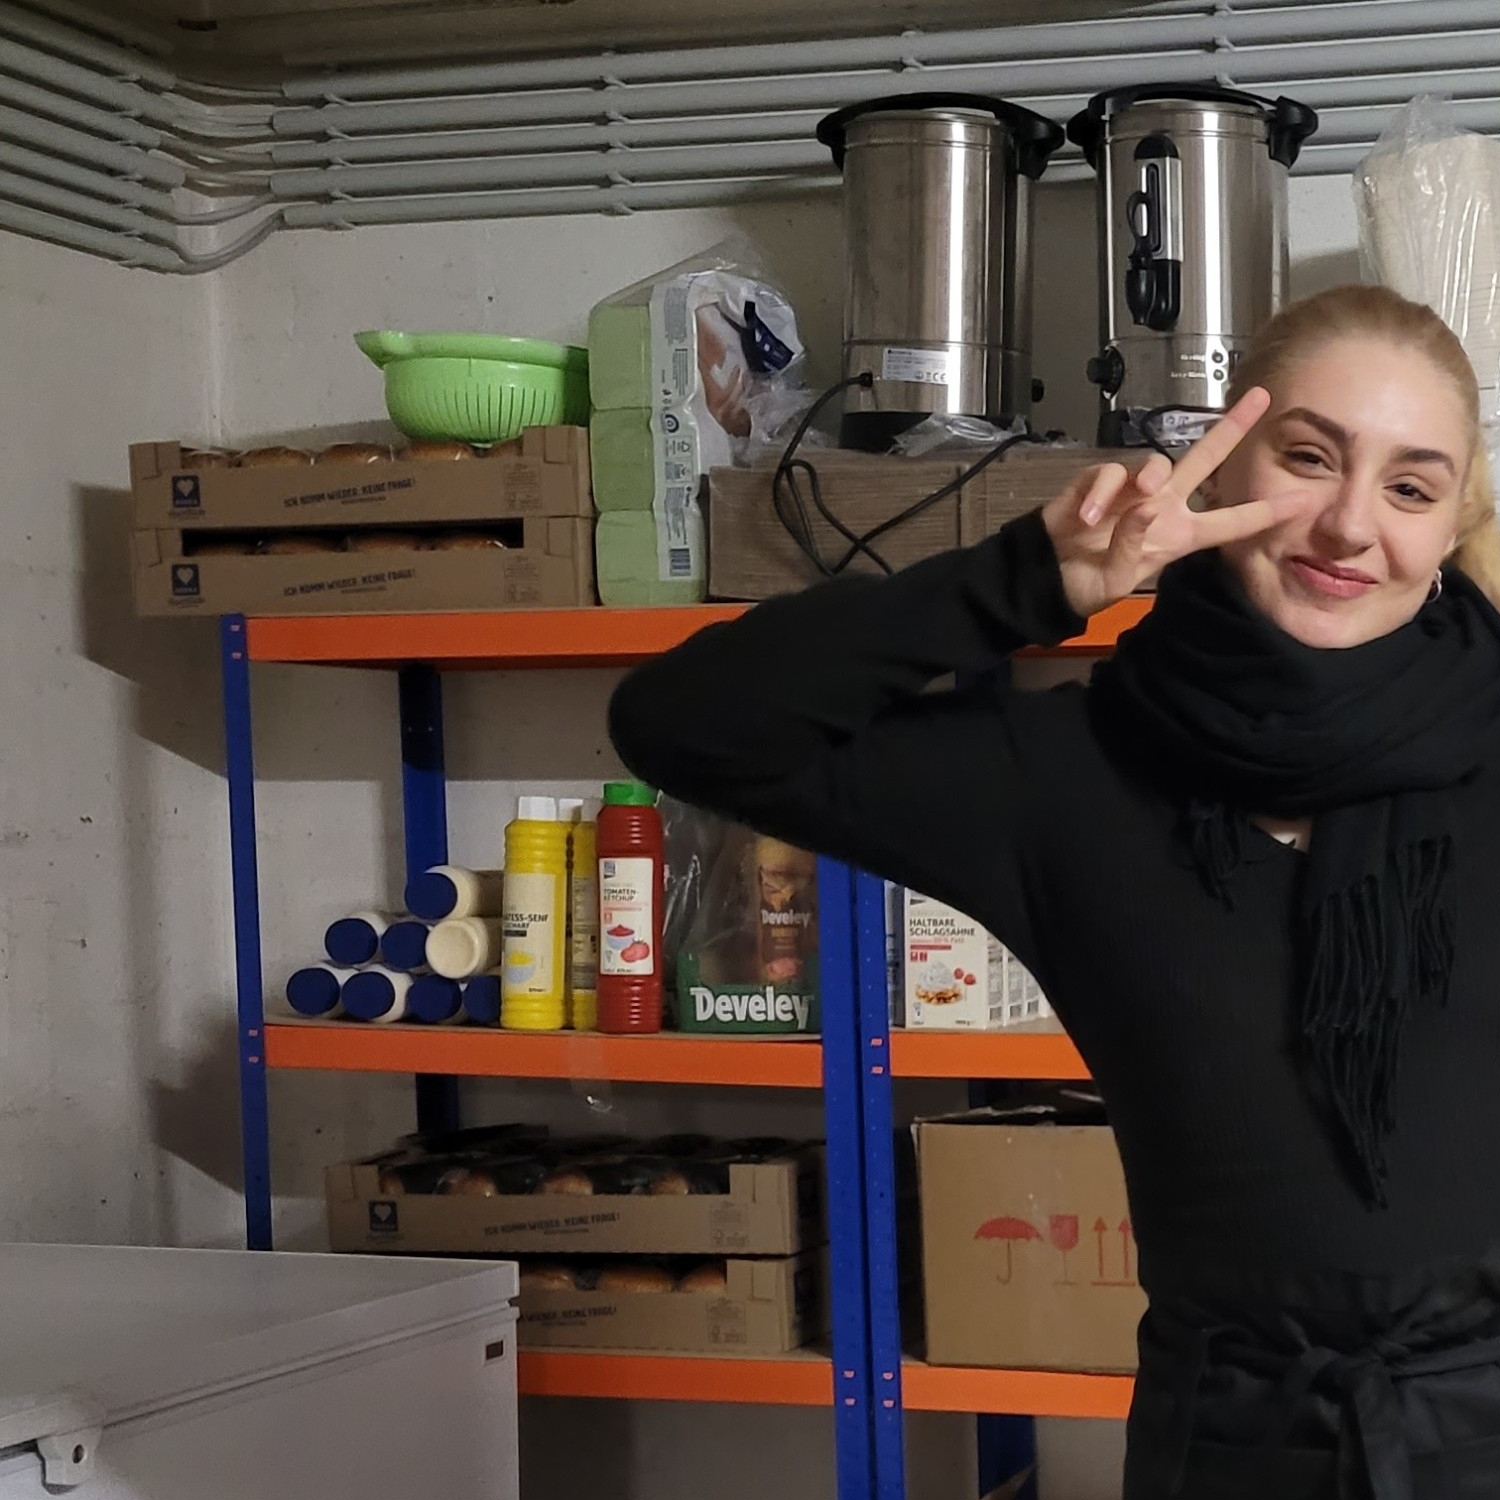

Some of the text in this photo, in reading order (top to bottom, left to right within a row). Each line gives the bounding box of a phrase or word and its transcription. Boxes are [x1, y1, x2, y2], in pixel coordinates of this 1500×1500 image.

[761, 909, 811, 928] Develey
[909, 918, 956, 927] HALTBARE
[909, 927, 976, 937] SCHLAGSAHNE
[689, 985, 815, 1031] Develey
